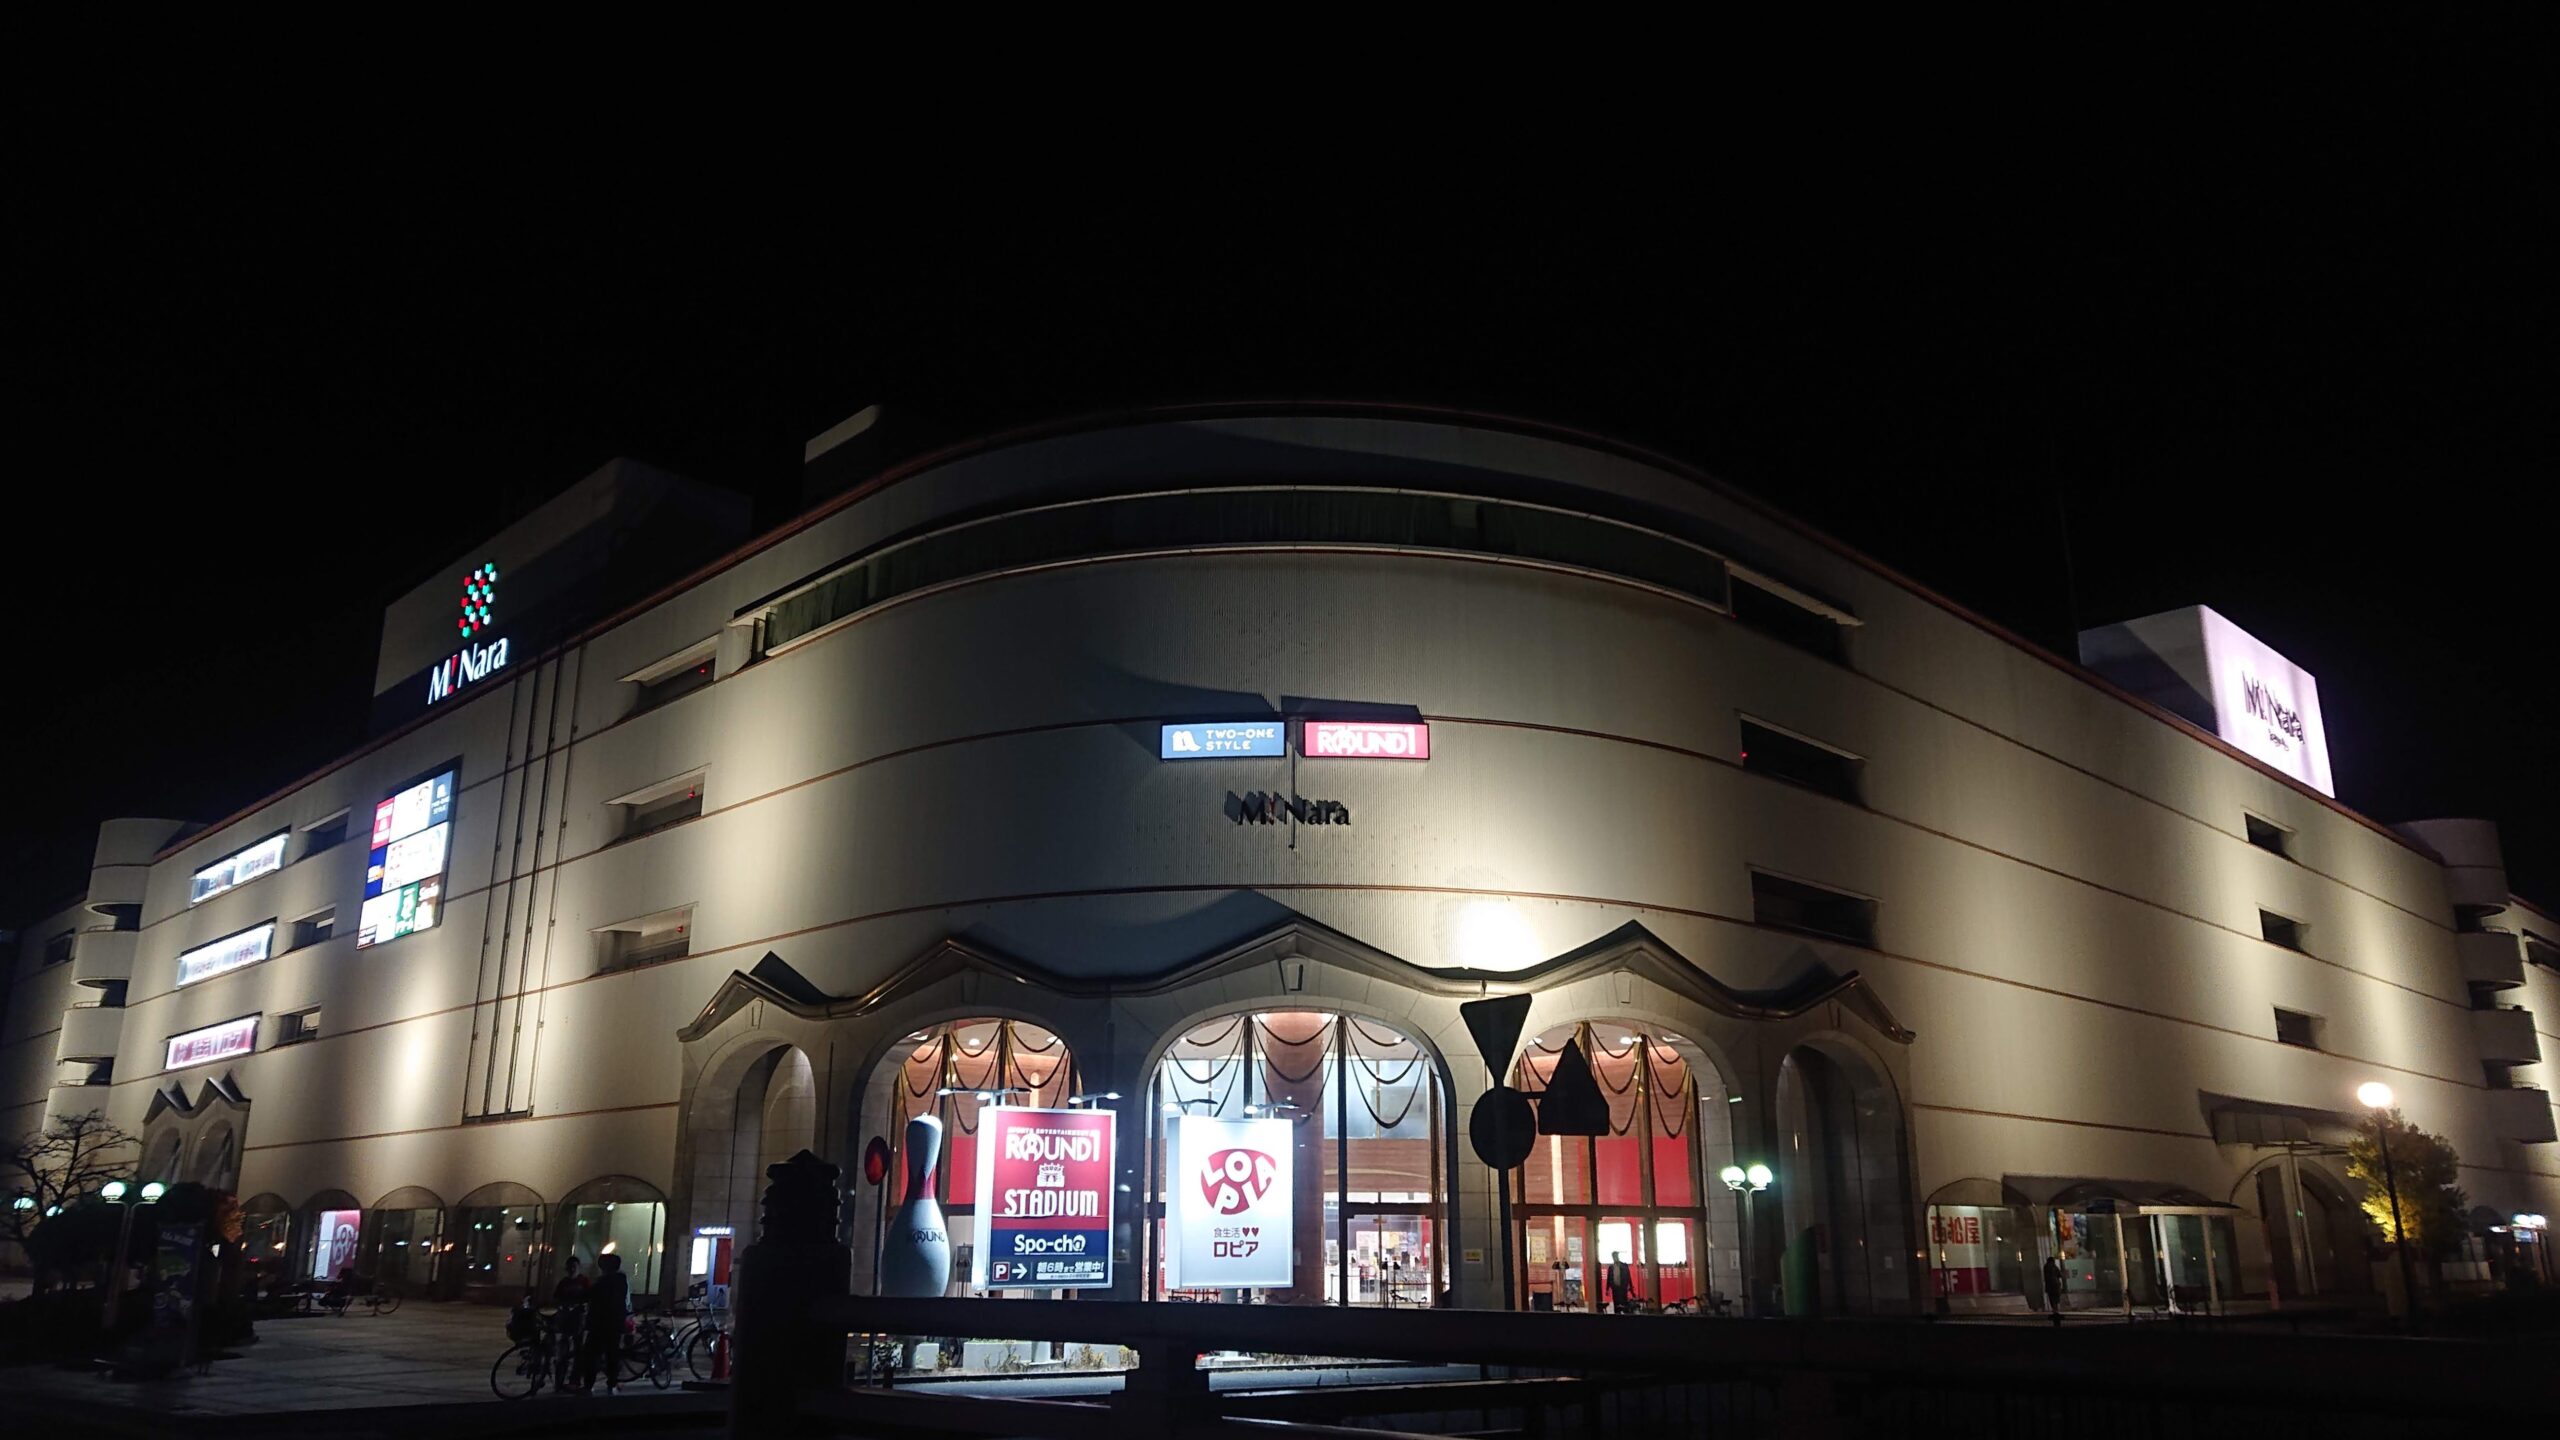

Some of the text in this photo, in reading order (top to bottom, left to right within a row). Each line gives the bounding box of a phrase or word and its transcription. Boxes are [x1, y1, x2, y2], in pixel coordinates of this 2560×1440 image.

[1206, 728, 1275, 740] TWO-ONE
[1205, 740, 1252, 752] STYLE
[1004, 1189, 1099, 1217] STADIUM
[1930, 1215, 1981, 1245] 西松屋
[1213, 1240, 1259, 1258] ロピア
[995, 1264, 1007, 1279] P
